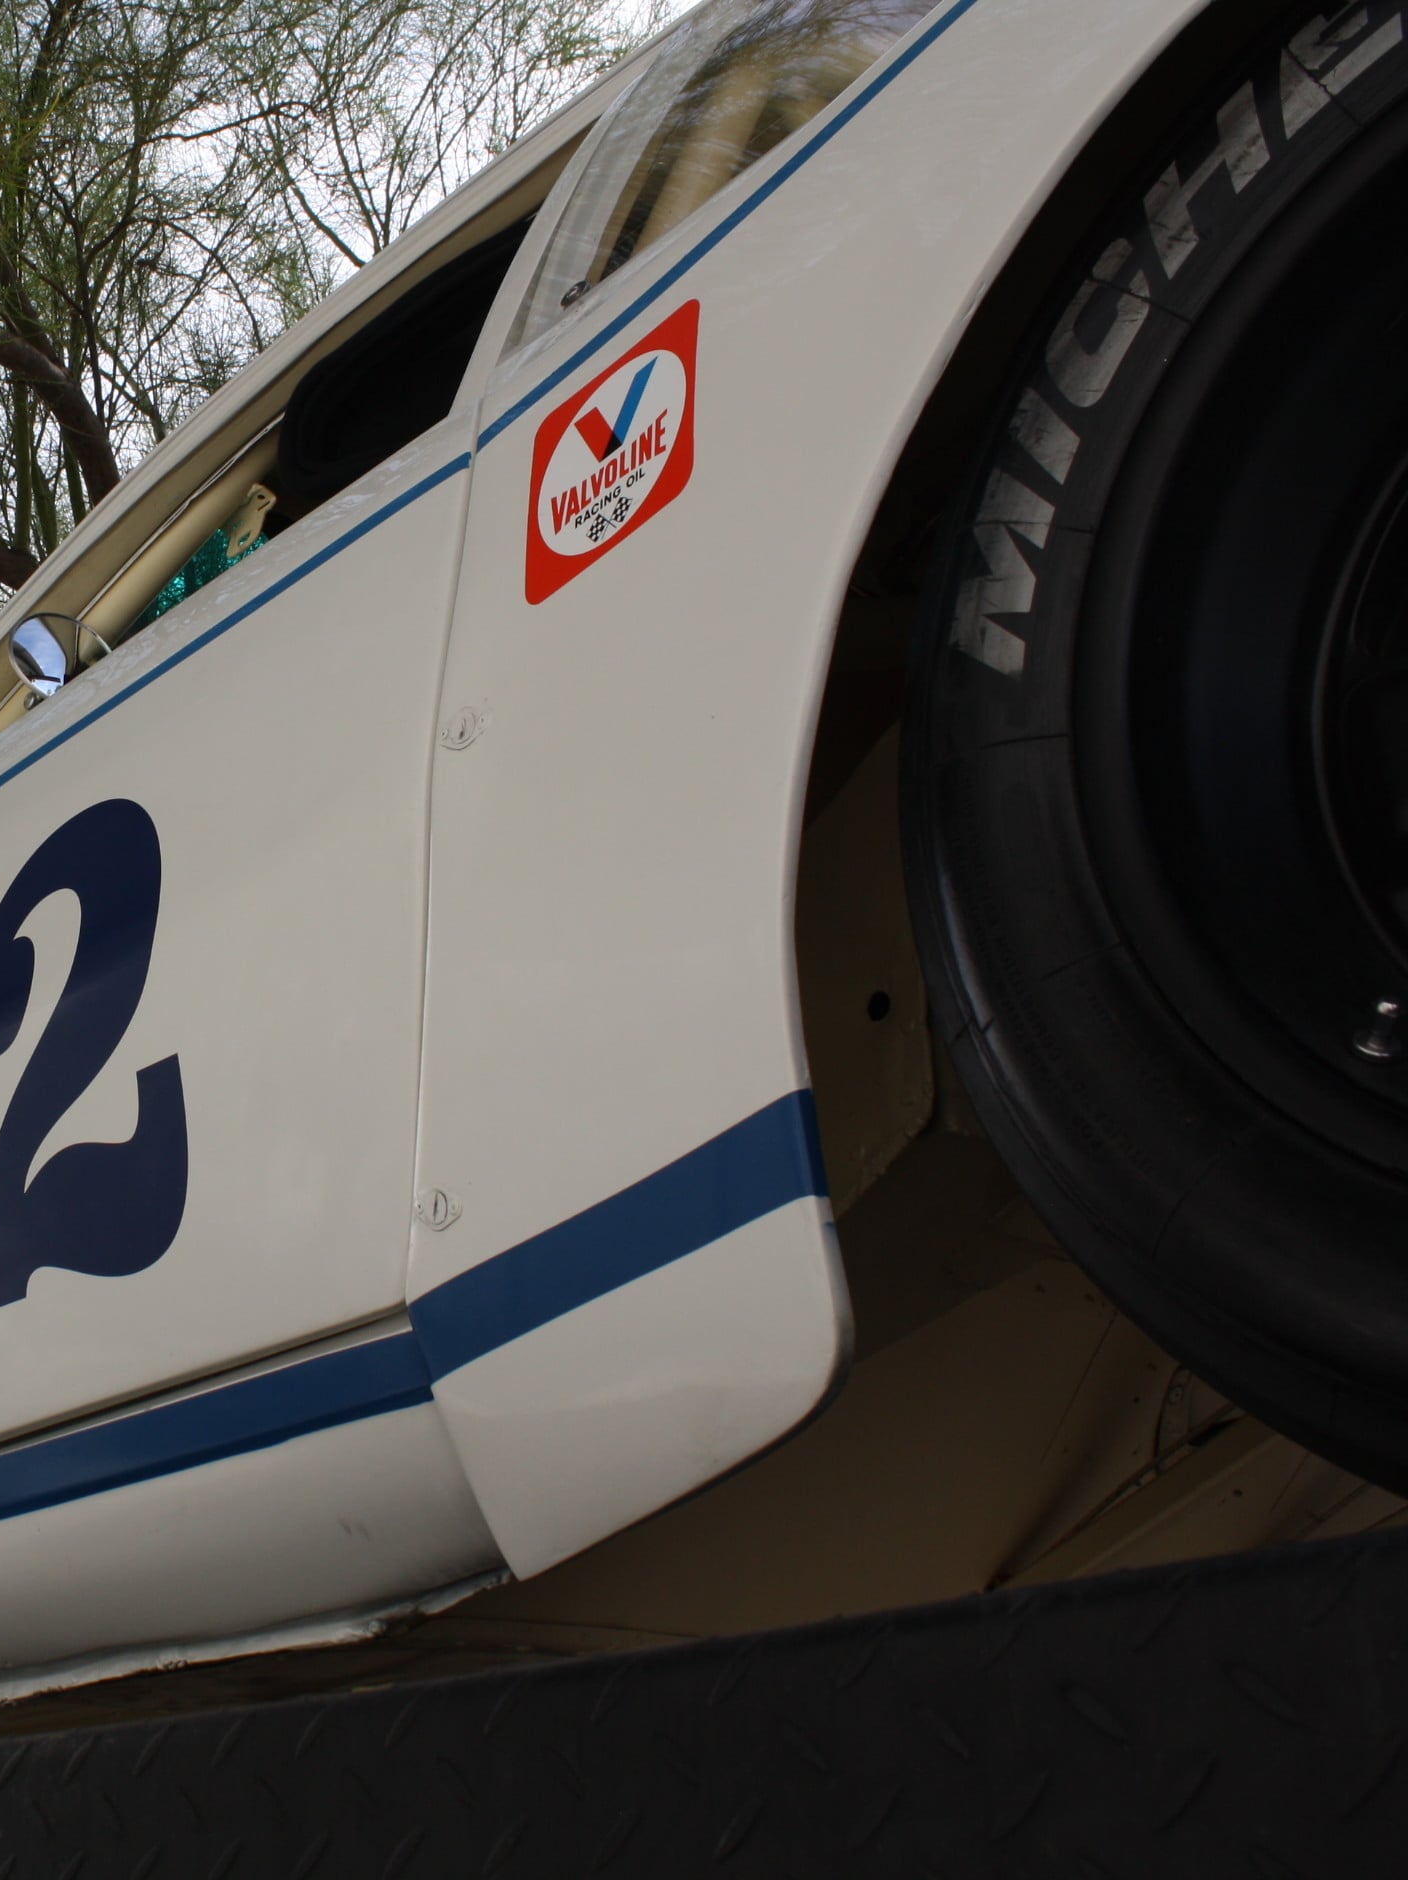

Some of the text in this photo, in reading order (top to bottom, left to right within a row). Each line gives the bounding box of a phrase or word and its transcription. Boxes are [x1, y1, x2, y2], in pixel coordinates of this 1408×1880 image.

[550, 408, 668, 536] VALVOLINE
[574, 467, 646, 530] RACING OIL
